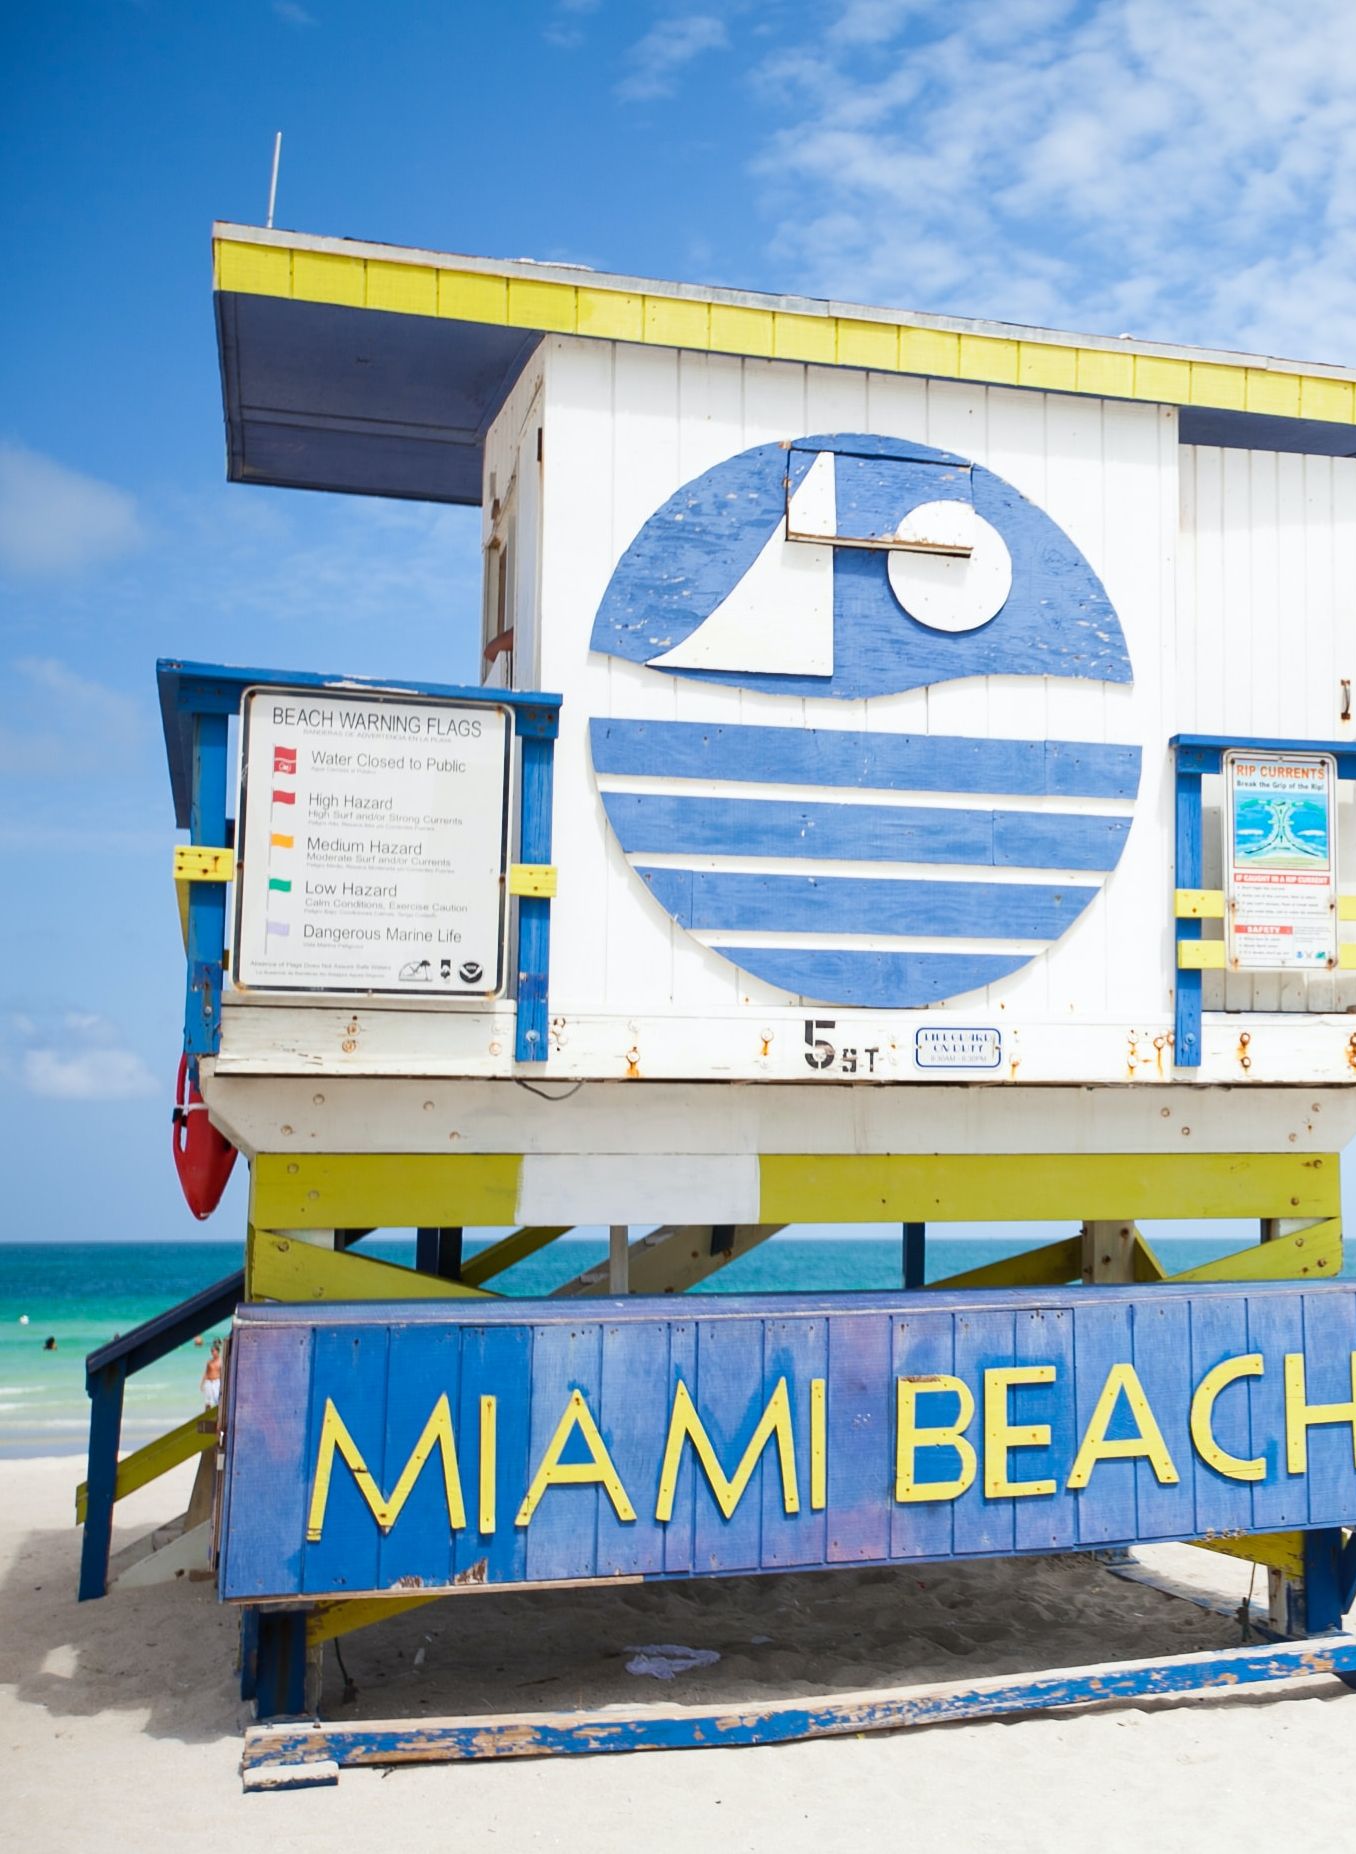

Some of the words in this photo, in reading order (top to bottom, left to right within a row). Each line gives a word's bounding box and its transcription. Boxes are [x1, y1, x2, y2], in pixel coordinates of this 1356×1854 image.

[273, 706, 333, 728] BEACH
[340, 711, 420, 734] WARNING
[427, 717, 482, 738] FLAGS
[312, 750, 352, 766] Water
[357, 753, 405, 769] Closed
[409, 757, 422, 770] to
[427, 757, 466, 773] Public
[1236, 764, 1256, 777] RIP
[1260, 765, 1325, 780] CURRENTS
[1272, 782, 1287, 790] Grip
[309, 792, 339, 811] High
[344, 794, 393, 810] Hazard
[308, 809, 330, 819] High
[333, 810, 353, 819] Surf
[356, 812, 385, 821] and/or
[389, 813, 420, 824] Strong
[423, 815, 463, 825] Currents
[307, 837, 364, 853] Medium
[370, 840, 422, 856] Hazard
[307, 852, 352, 862] Moderate
[356, 854, 376, 863] Surf
[411, 856, 451, 867] Currents
[305, 880, 337, 895] Low
[343, 881, 397, 898] Hazard
[305, 898, 331, 907] Calm
[389, 901, 429, 911] Exercise
[432, 902, 468, 912] Caution
[304, 924, 381, 942] Dangerous
[386, 927, 433, 943] Marine
[438, 928, 462, 943] Life
[1247, 925, 1280, 934] SAFETY
[307, 1376, 827, 1542] MIAMI
